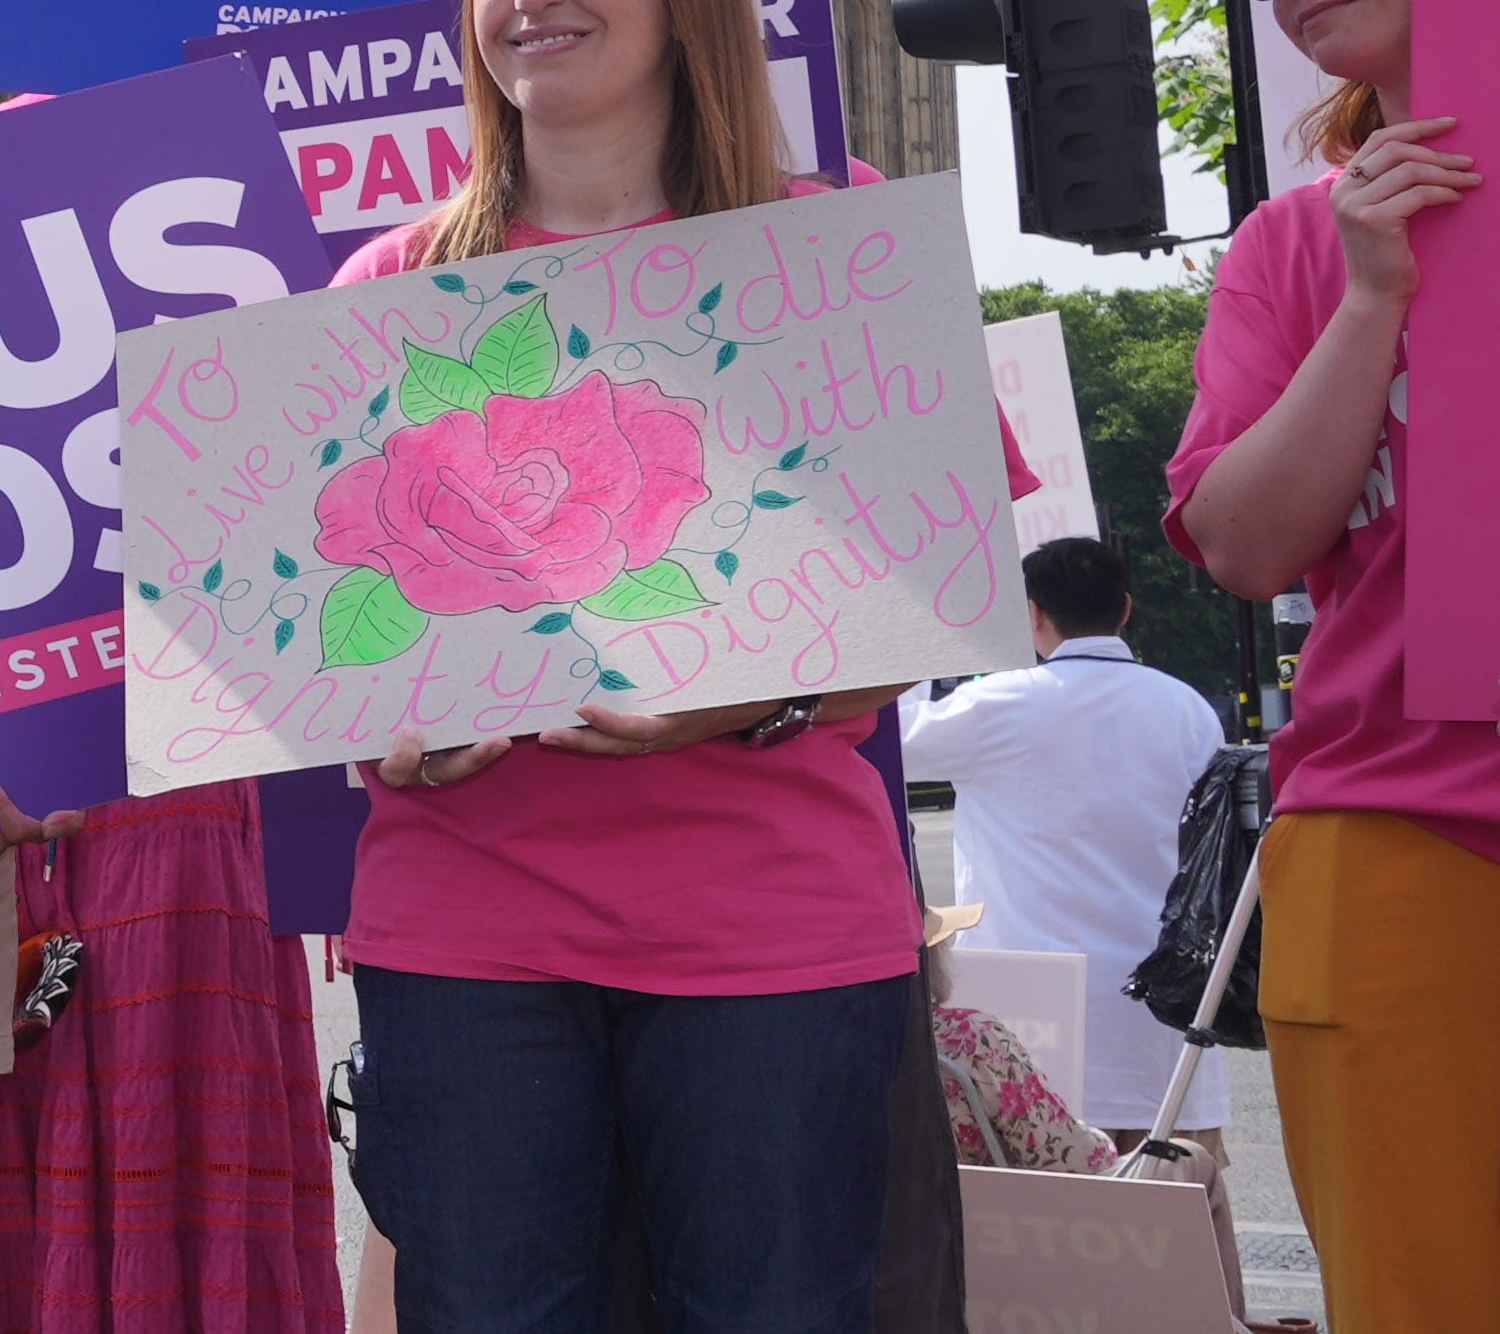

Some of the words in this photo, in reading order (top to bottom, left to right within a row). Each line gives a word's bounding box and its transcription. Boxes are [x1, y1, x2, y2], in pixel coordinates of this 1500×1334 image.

[736, 224, 913, 334] die
[141, 442, 295, 584] Live
[608, 468, 998, 701] Dignity
[130, 588, 569, 763] Dignity
